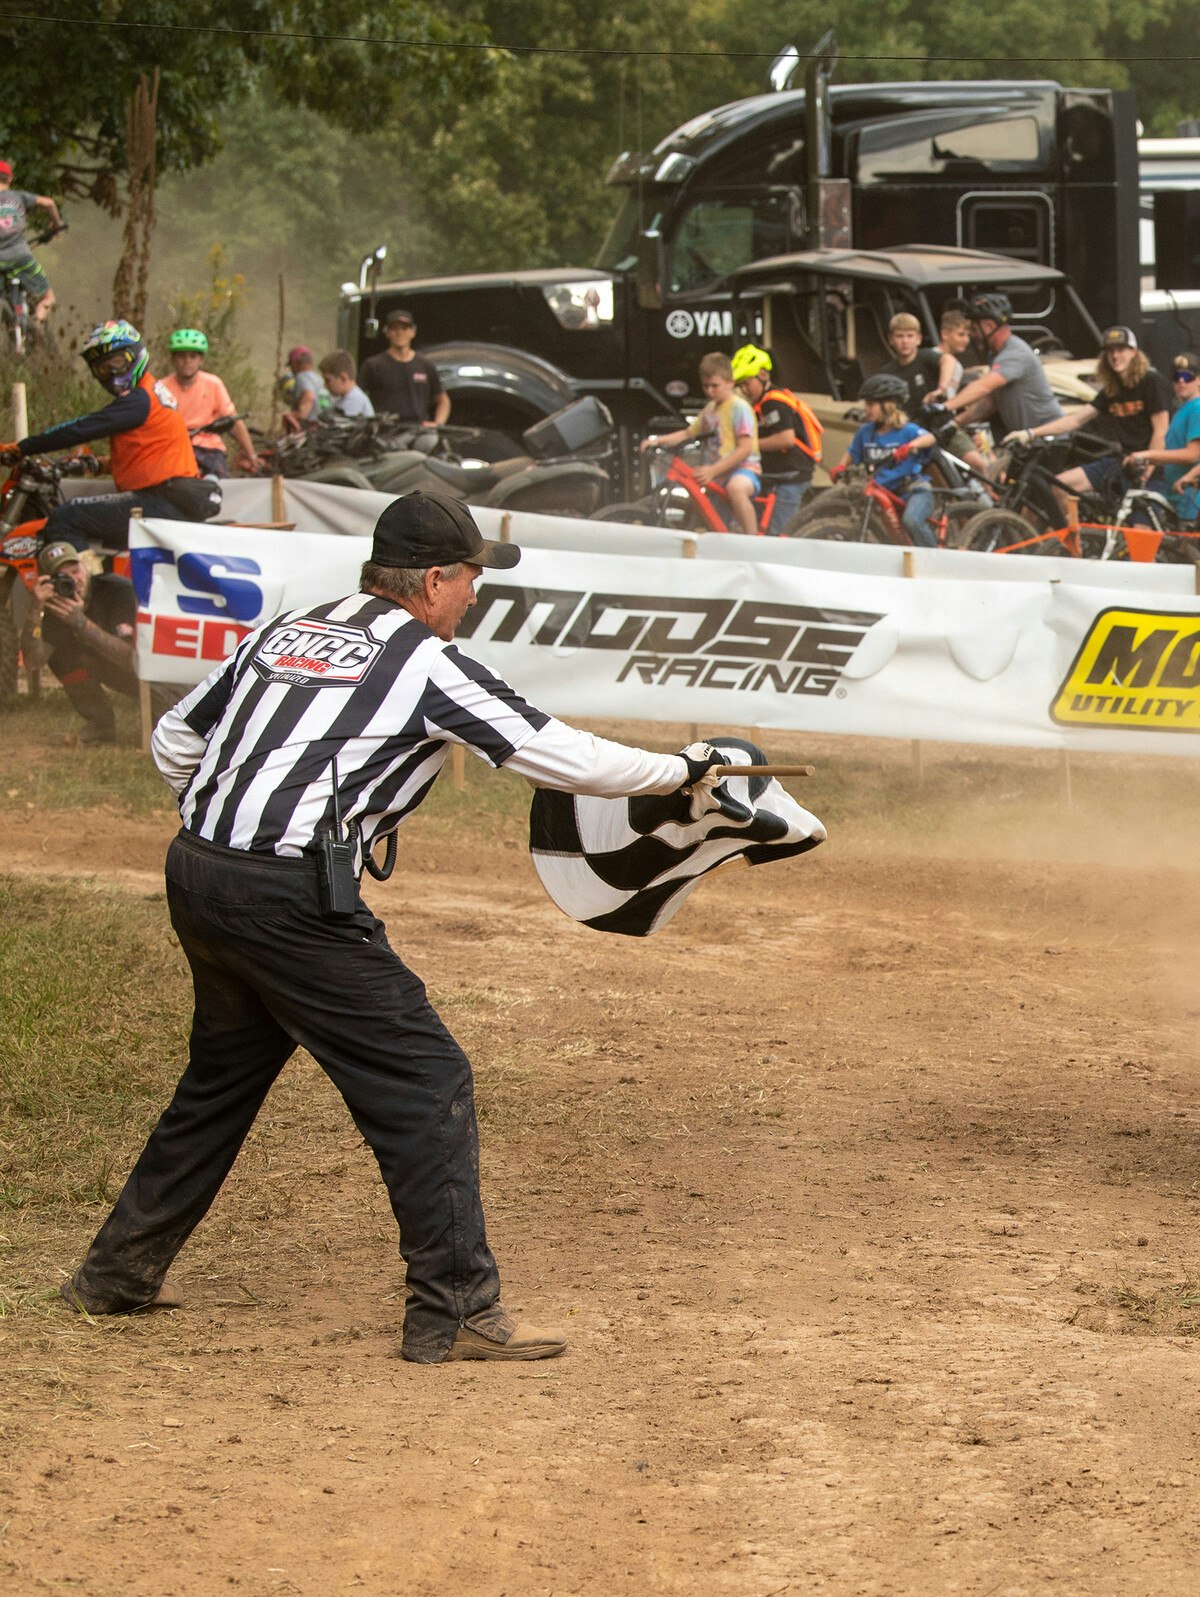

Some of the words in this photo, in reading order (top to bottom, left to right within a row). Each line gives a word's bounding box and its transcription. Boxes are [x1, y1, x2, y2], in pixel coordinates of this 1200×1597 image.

[136, 611, 255, 662] ED
[455, 583, 888, 667] MOOSE
[262, 627, 374, 669] GNCC
[273, 655, 331, 675] RACING
[616, 655, 842, 697] RACING
[1070, 694, 1193, 717] UTILITY
